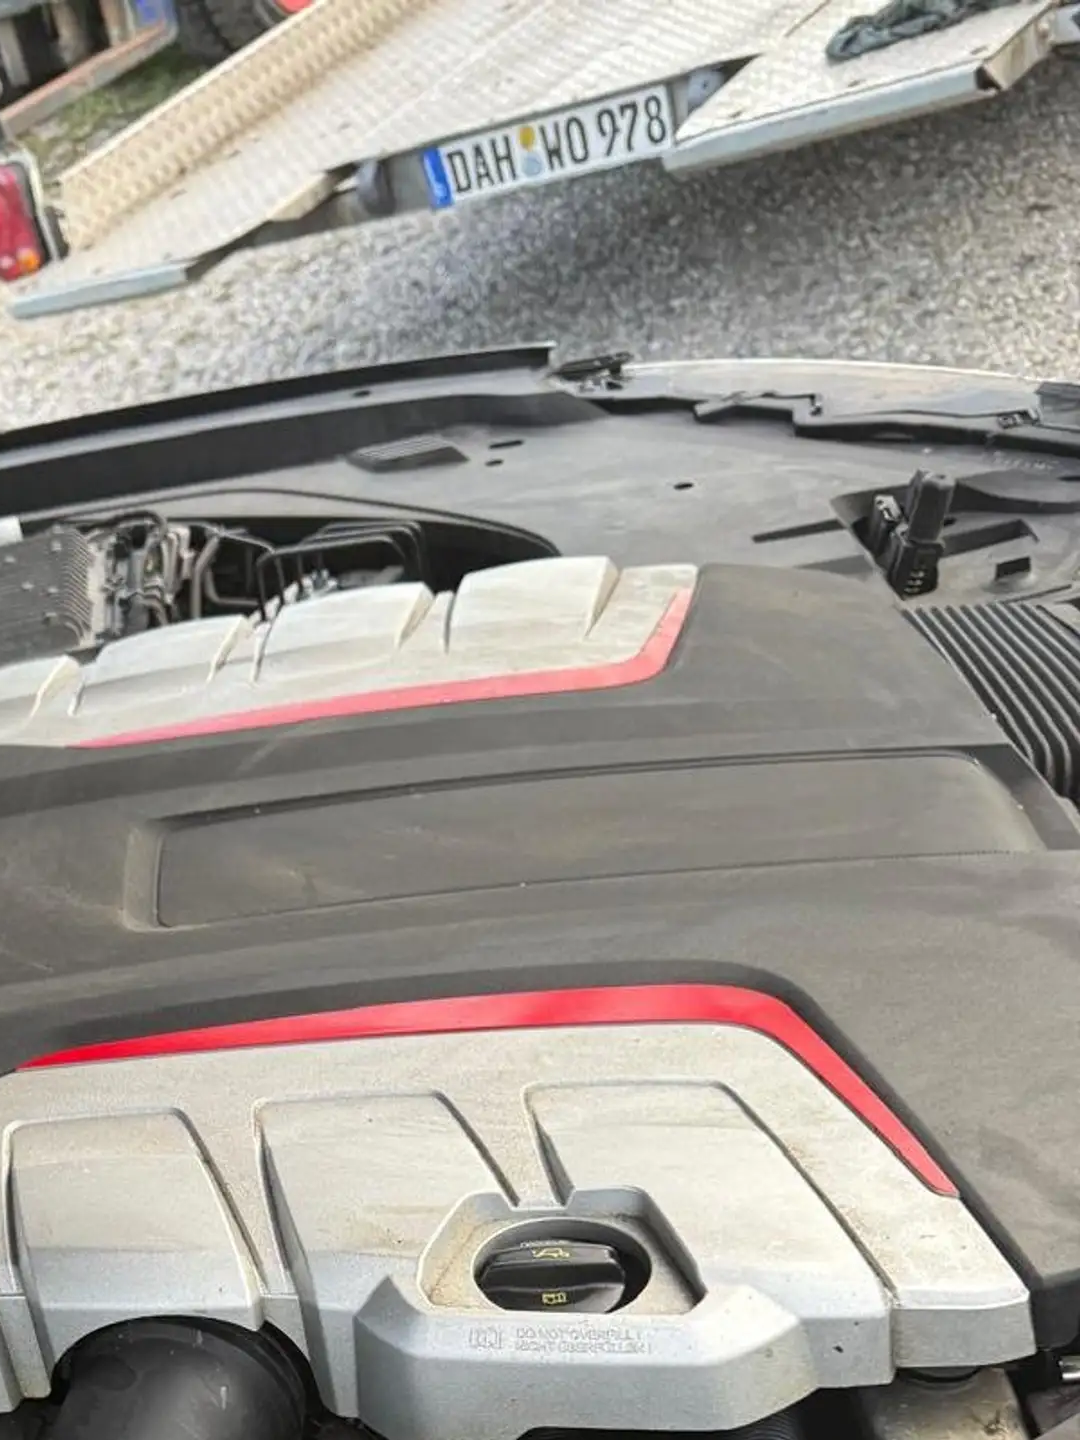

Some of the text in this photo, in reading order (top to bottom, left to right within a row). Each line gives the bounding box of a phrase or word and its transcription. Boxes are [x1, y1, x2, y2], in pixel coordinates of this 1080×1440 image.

[447, 95, 666, 194] DAH WO 978
